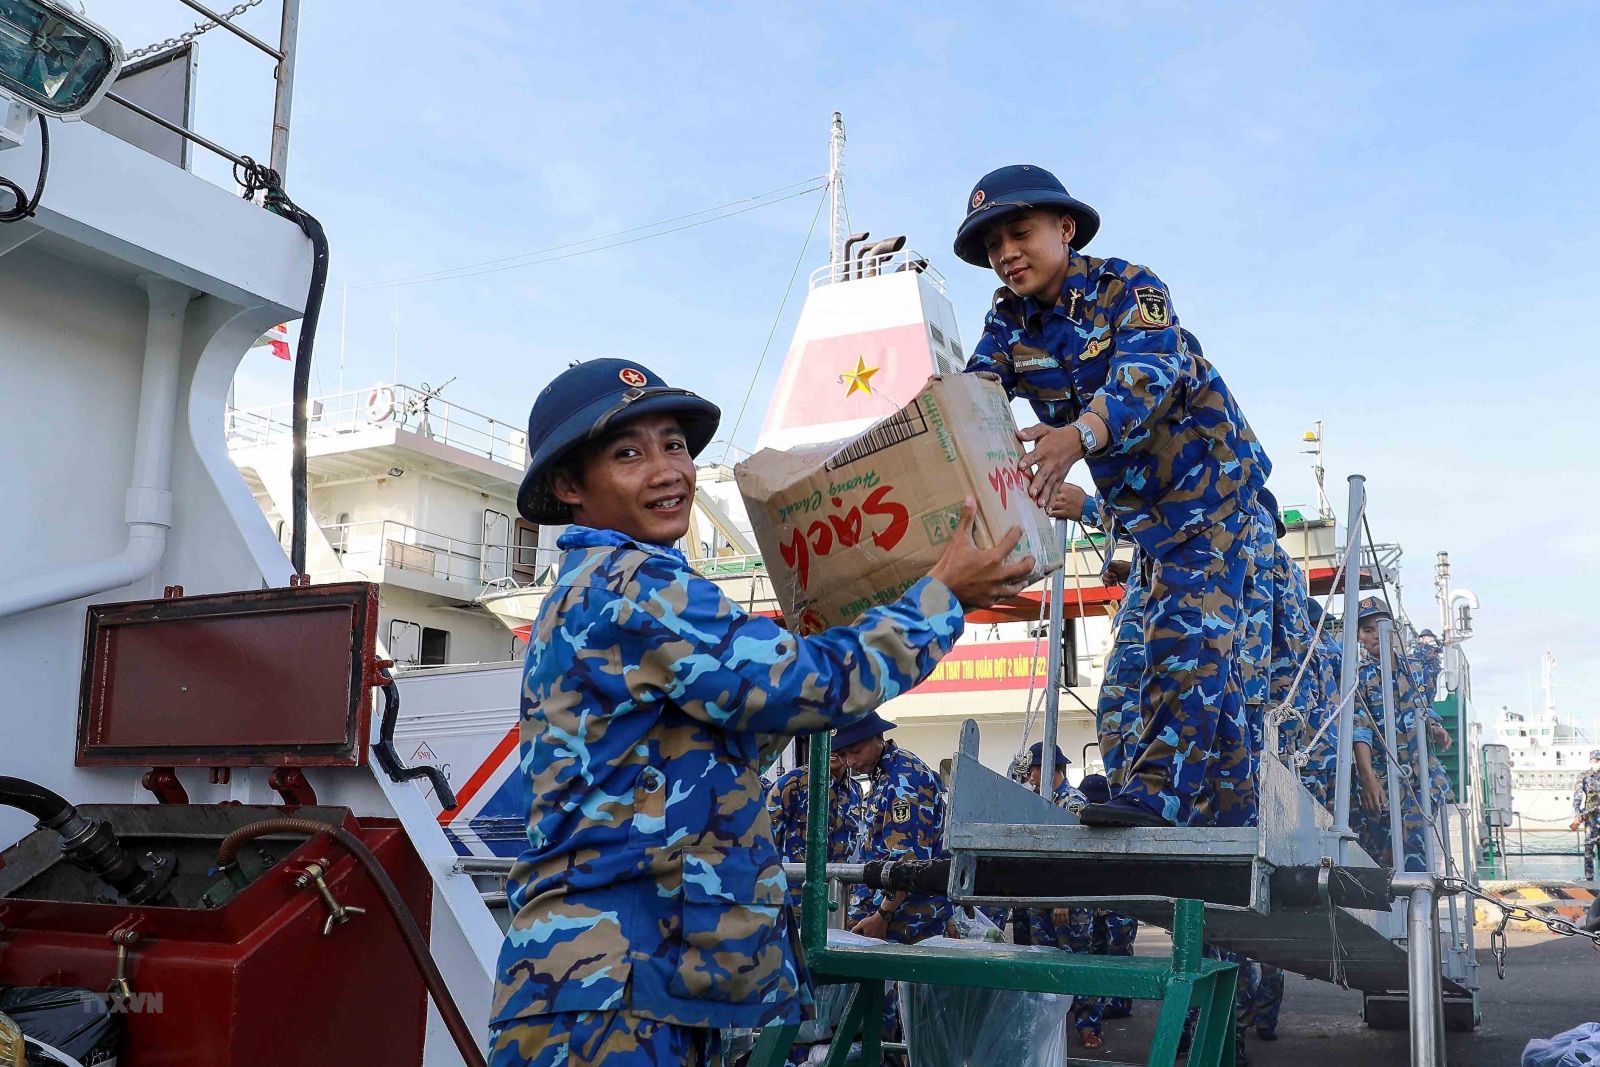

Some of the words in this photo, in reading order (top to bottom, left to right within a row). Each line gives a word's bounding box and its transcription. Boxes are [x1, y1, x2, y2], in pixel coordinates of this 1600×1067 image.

[987, 457, 1033, 511] ạch
[779, 490, 822, 523] Chanh
[780, 485, 910, 592] Sạch
[1008, 658, 1012, 677] 2
[1030, 655, 1046, 676] 222
